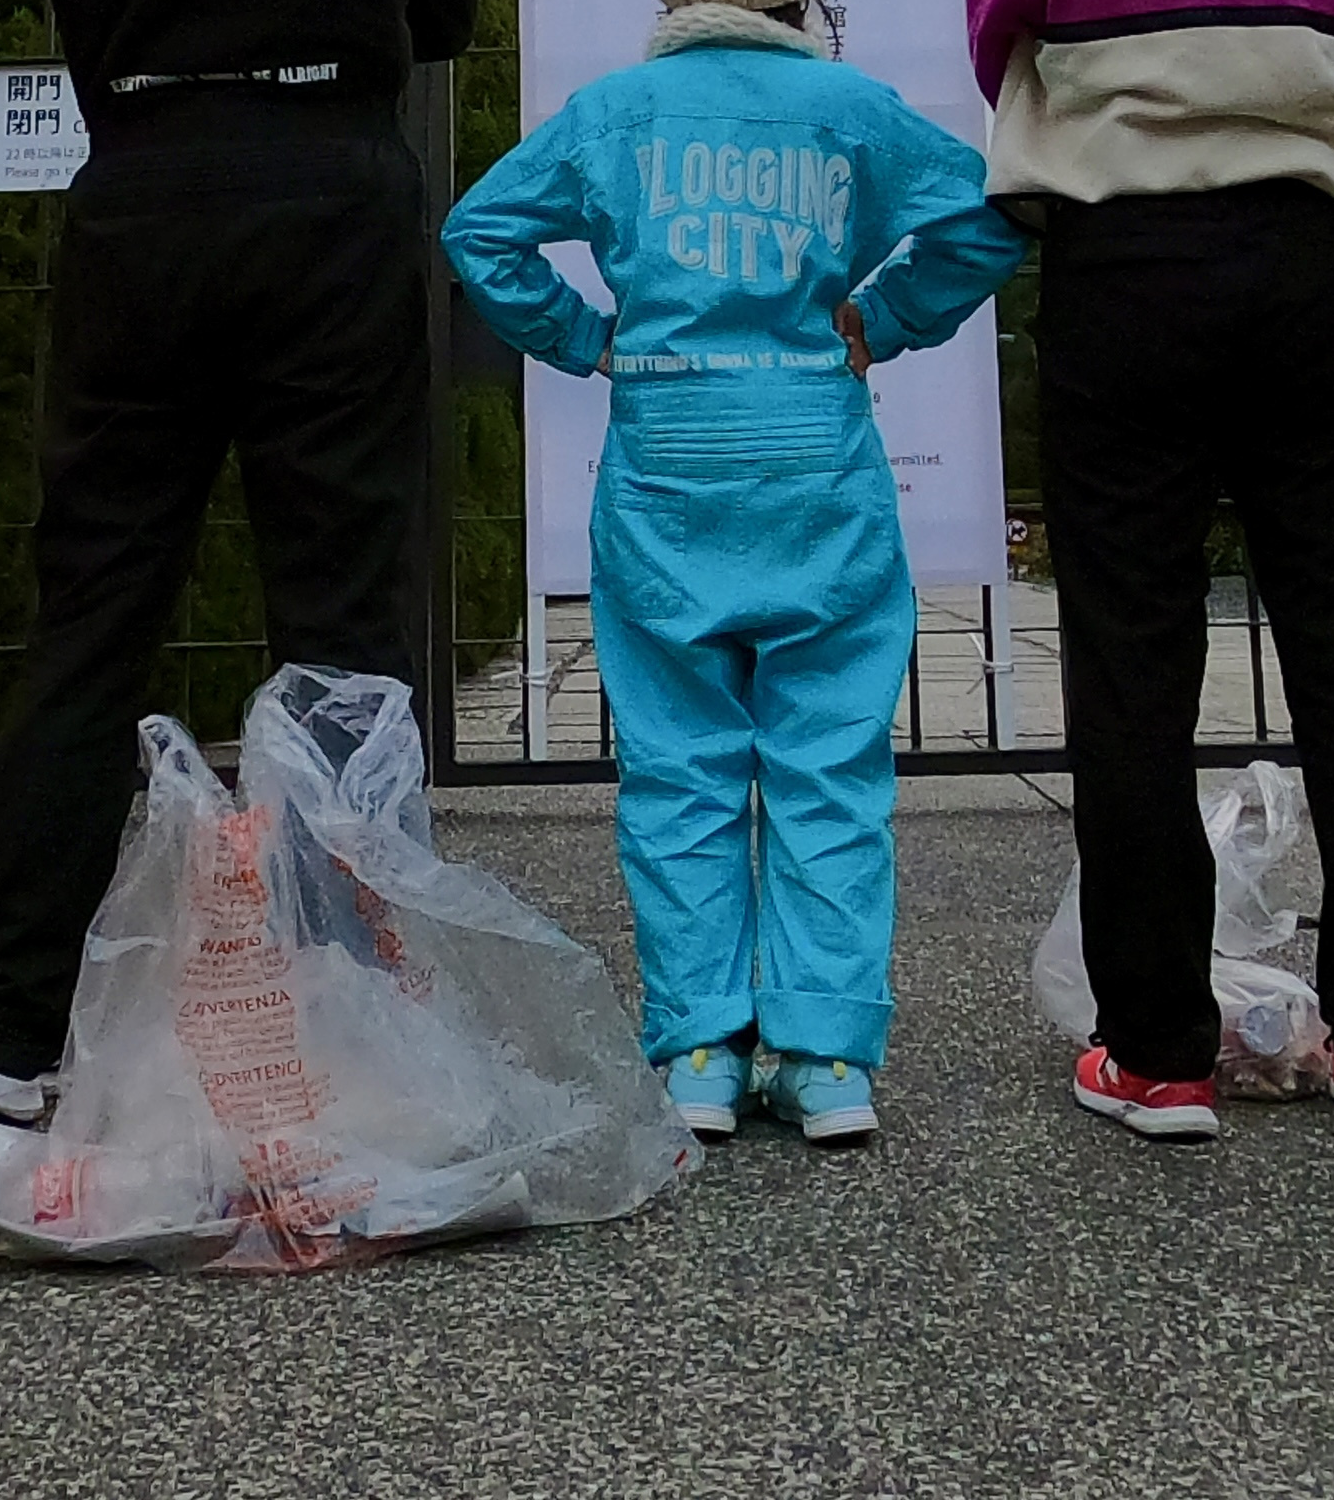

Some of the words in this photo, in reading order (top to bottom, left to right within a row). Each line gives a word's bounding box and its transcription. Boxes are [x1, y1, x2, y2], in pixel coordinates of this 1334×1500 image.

[7, 74, 62, 102] 開門
[6, 108, 61, 136] 閉門
[669, 211, 815, 283] CITY
